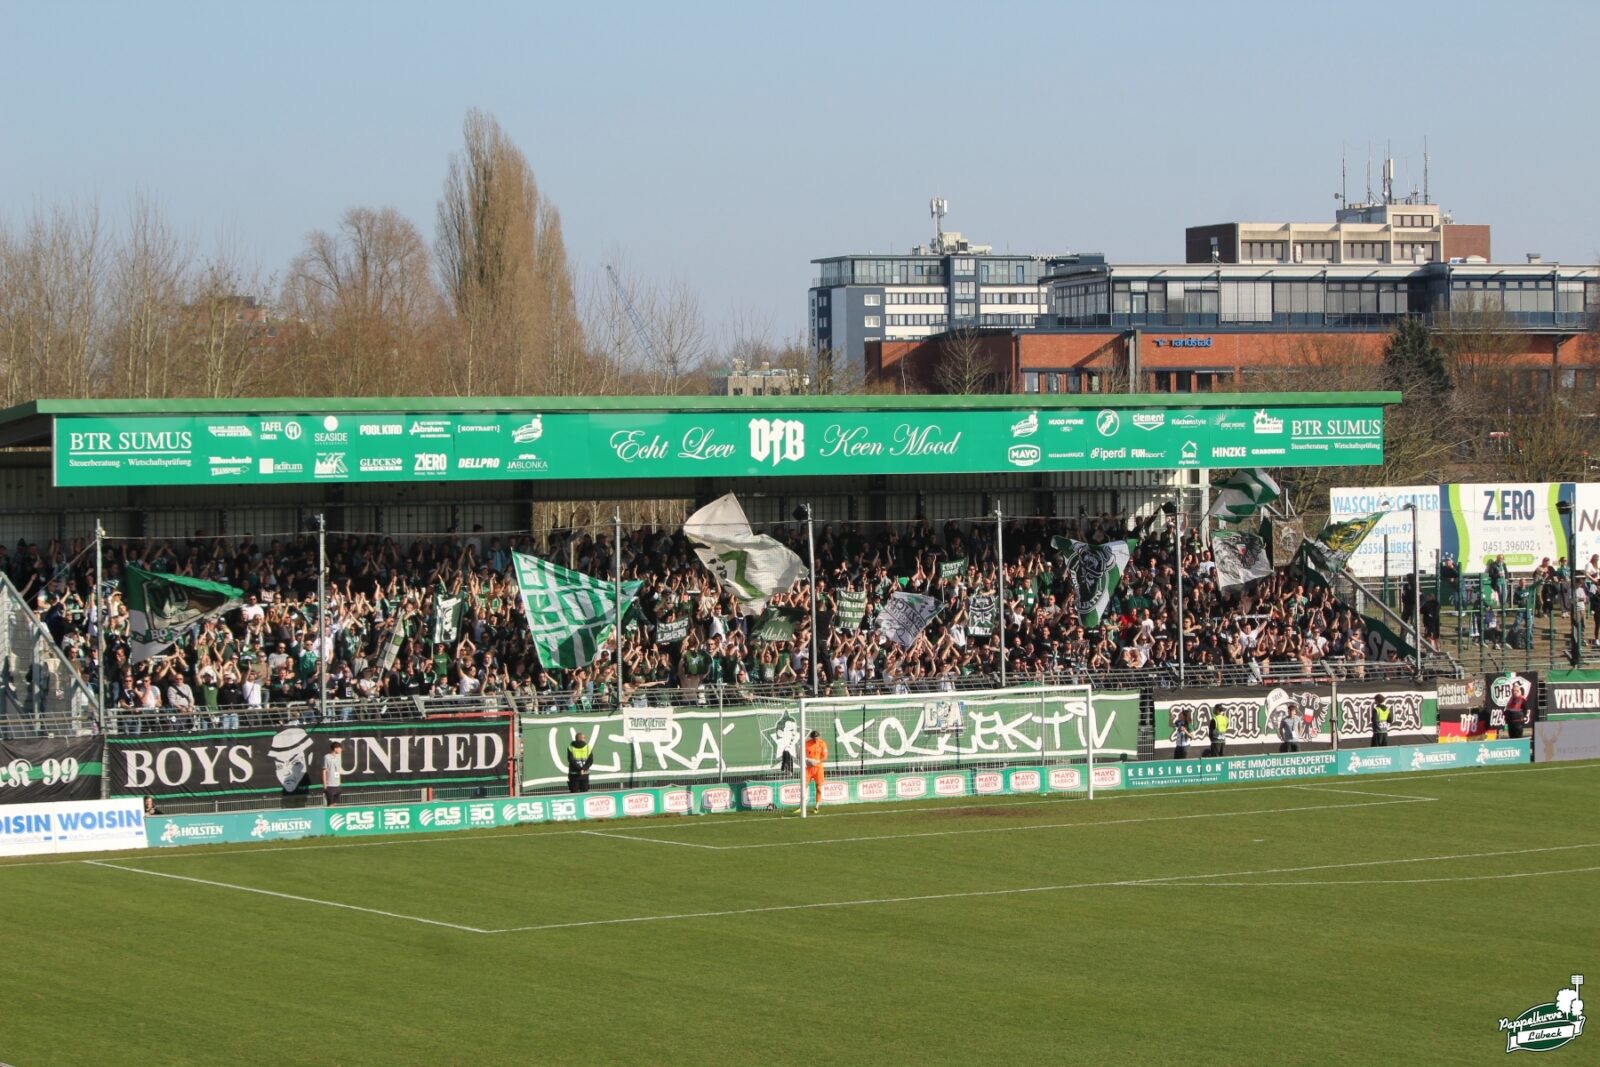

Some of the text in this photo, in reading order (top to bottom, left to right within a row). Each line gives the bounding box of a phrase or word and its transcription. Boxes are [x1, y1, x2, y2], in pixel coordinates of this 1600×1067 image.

[1172, 337, 1212, 347] randstad
[1132, 412, 1165, 422] clement
[260, 421, 283, 432] TAFEL
[1291, 419, 1323, 436] BTR
[1327, 419, 1381, 435] SUMUS
[69, 432, 113, 450] BTR
[119, 431, 192, 450] SUMUS
[314, 432, 348, 442] SEASIDE
[819, 423, 962, 457] Keen Mood
[609, 426, 736, 463] Echt Leev
[1011, 449, 1038, 459] MAYO
[1100, 447, 1127, 461] iperdi
[1212, 446, 1247, 458] HINZKE
[458, 458, 500, 469] DELLPRO
[506, 461, 548, 470] JABLONKA
[1332, 495, 1375, 513] WASCH
[1358, 542, 1383, 555] 23556
[121, 732, 504, 788] BOYS UNITED
[1424, 753, 1457, 763] HOLSTEN
[1490, 749, 1521, 758] HOLSTEN
[1228, 755, 1336, 769] IHRE IMMOBILIENEXPERTEN
[1362, 757, 1392, 767] HOLSTEN
[41, 756, 79, 786] 99
[1128, 764, 1222, 777] KENSINGTON
[1228, 765, 1327, 779] IN DER LÜBECKER BUCHT.
[707, 790, 728, 798] MAYO
[434, 807, 461, 819] FLS
[470, 806, 495, 820] 30
[517, 802, 544, 815] FLS
[552, 802, 576, 816] 30
[57, 809, 142, 831] WOISIN
[345, 811, 375, 824] FLS
[384, 812, 410, 826] 30
[181, 825, 224, 837] HOLSTEN
[271, 820, 312, 831] HOLSTEN
[346, 823, 375, 831] GROUP
